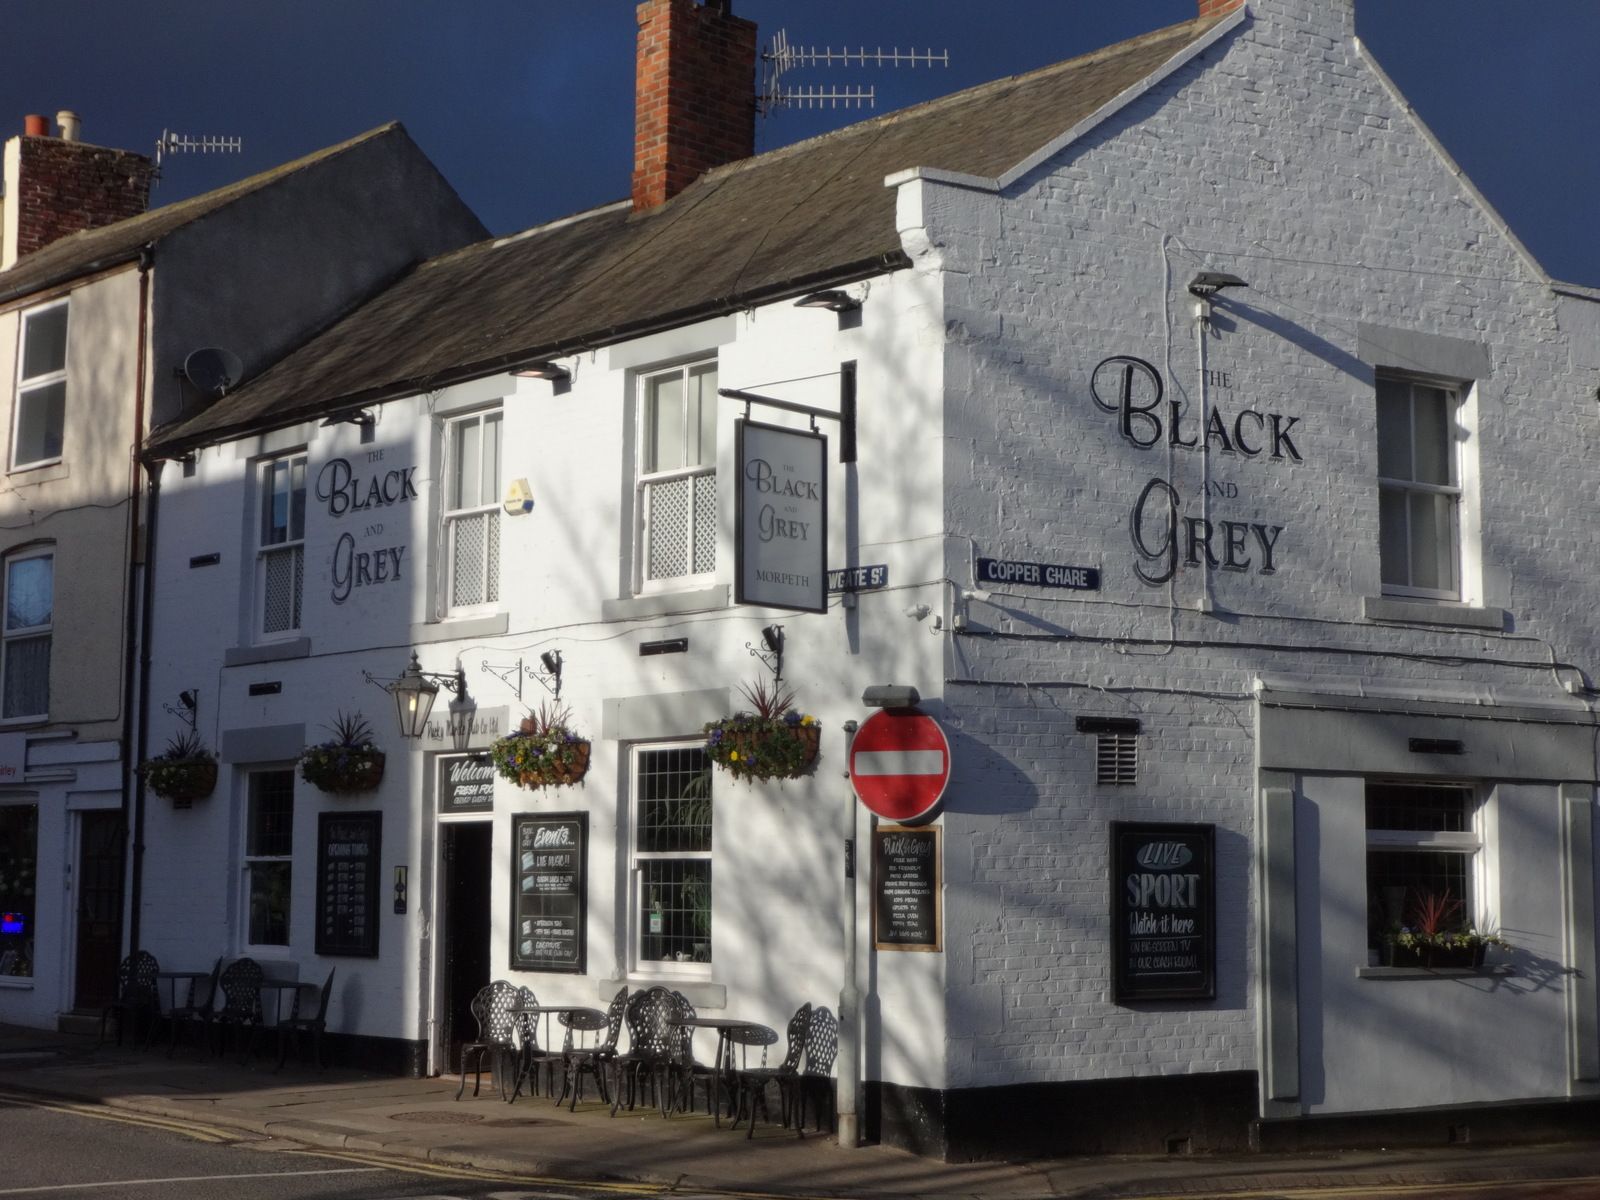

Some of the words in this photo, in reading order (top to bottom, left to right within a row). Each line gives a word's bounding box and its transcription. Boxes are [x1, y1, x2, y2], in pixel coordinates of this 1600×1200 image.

[1197, 368, 1233, 389] THE
[1089, 355, 1303, 465] BLACK
[367, 449, 384, 464] THE
[745, 458, 820, 501] BLACK
[783, 464, 795, 473] THE
[315, 458, 418, 518] BLACK
[1198, 480, 1239, 499] AND
[364, 524, 384, 537] AND
[758, 503, 811, 543] GREY
[1129, 477, 1285, 588] GREY
[331, 532, 406, 605] GREY
[756, 569, 809, 587] MORPETH
[827, 569, 868, 590] WGATE
[988, 561, 1040, 583] COPPER
[1045, 566, 1088, 587] CHARE
[449, 760, 494, 782] Welcom
[479, 783, 494, 795] FOO
[1143, 842, 1187, 865] LIVE
[1127, 873, 1200, 909] SPORT
[1130, 911, 1157, 935] Watch
[1161, 914, 1170, 934] it
[1171, 913, 1195, 934] here
